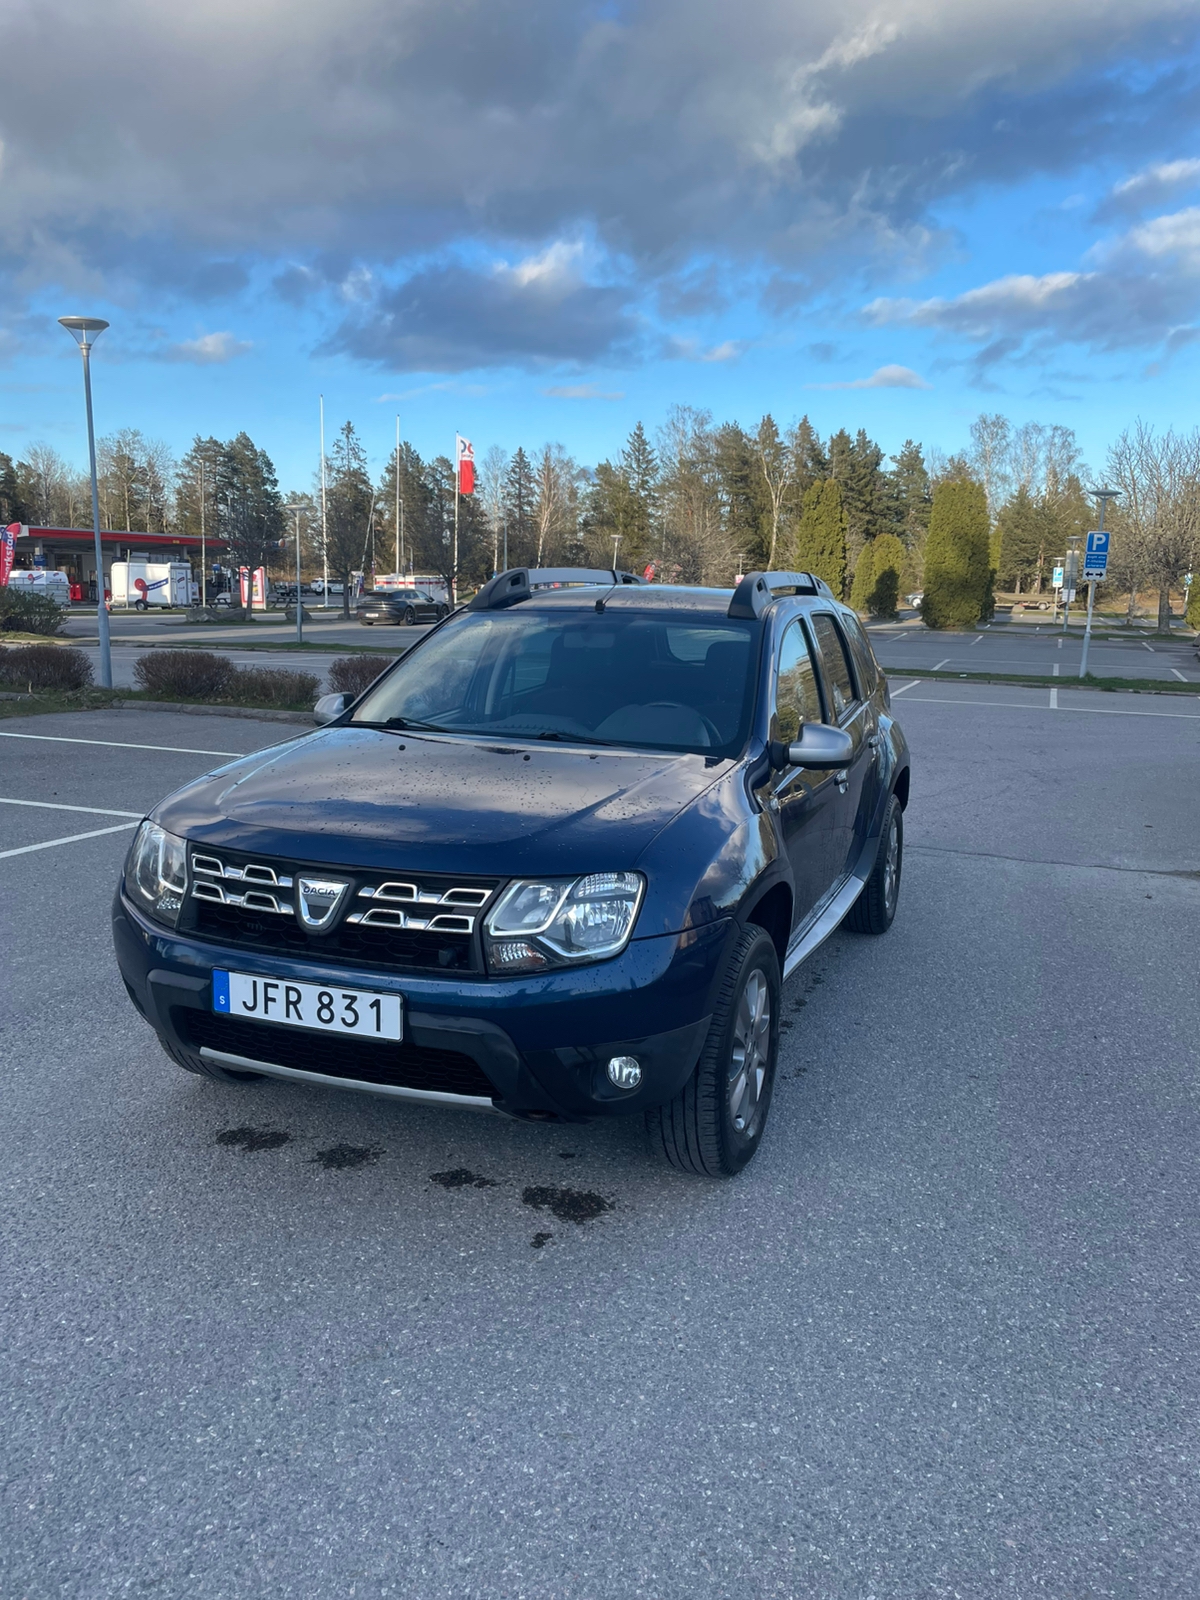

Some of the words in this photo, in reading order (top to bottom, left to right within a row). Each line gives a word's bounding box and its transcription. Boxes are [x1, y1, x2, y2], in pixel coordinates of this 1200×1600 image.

[1092, 534, 1106, 551] P
[303, 886, 336, 896] DACIA
[219, 995, 226, 1005] S
[242, 980, 303, 1021] JFR
[316, 991, 382, 1032] 831
